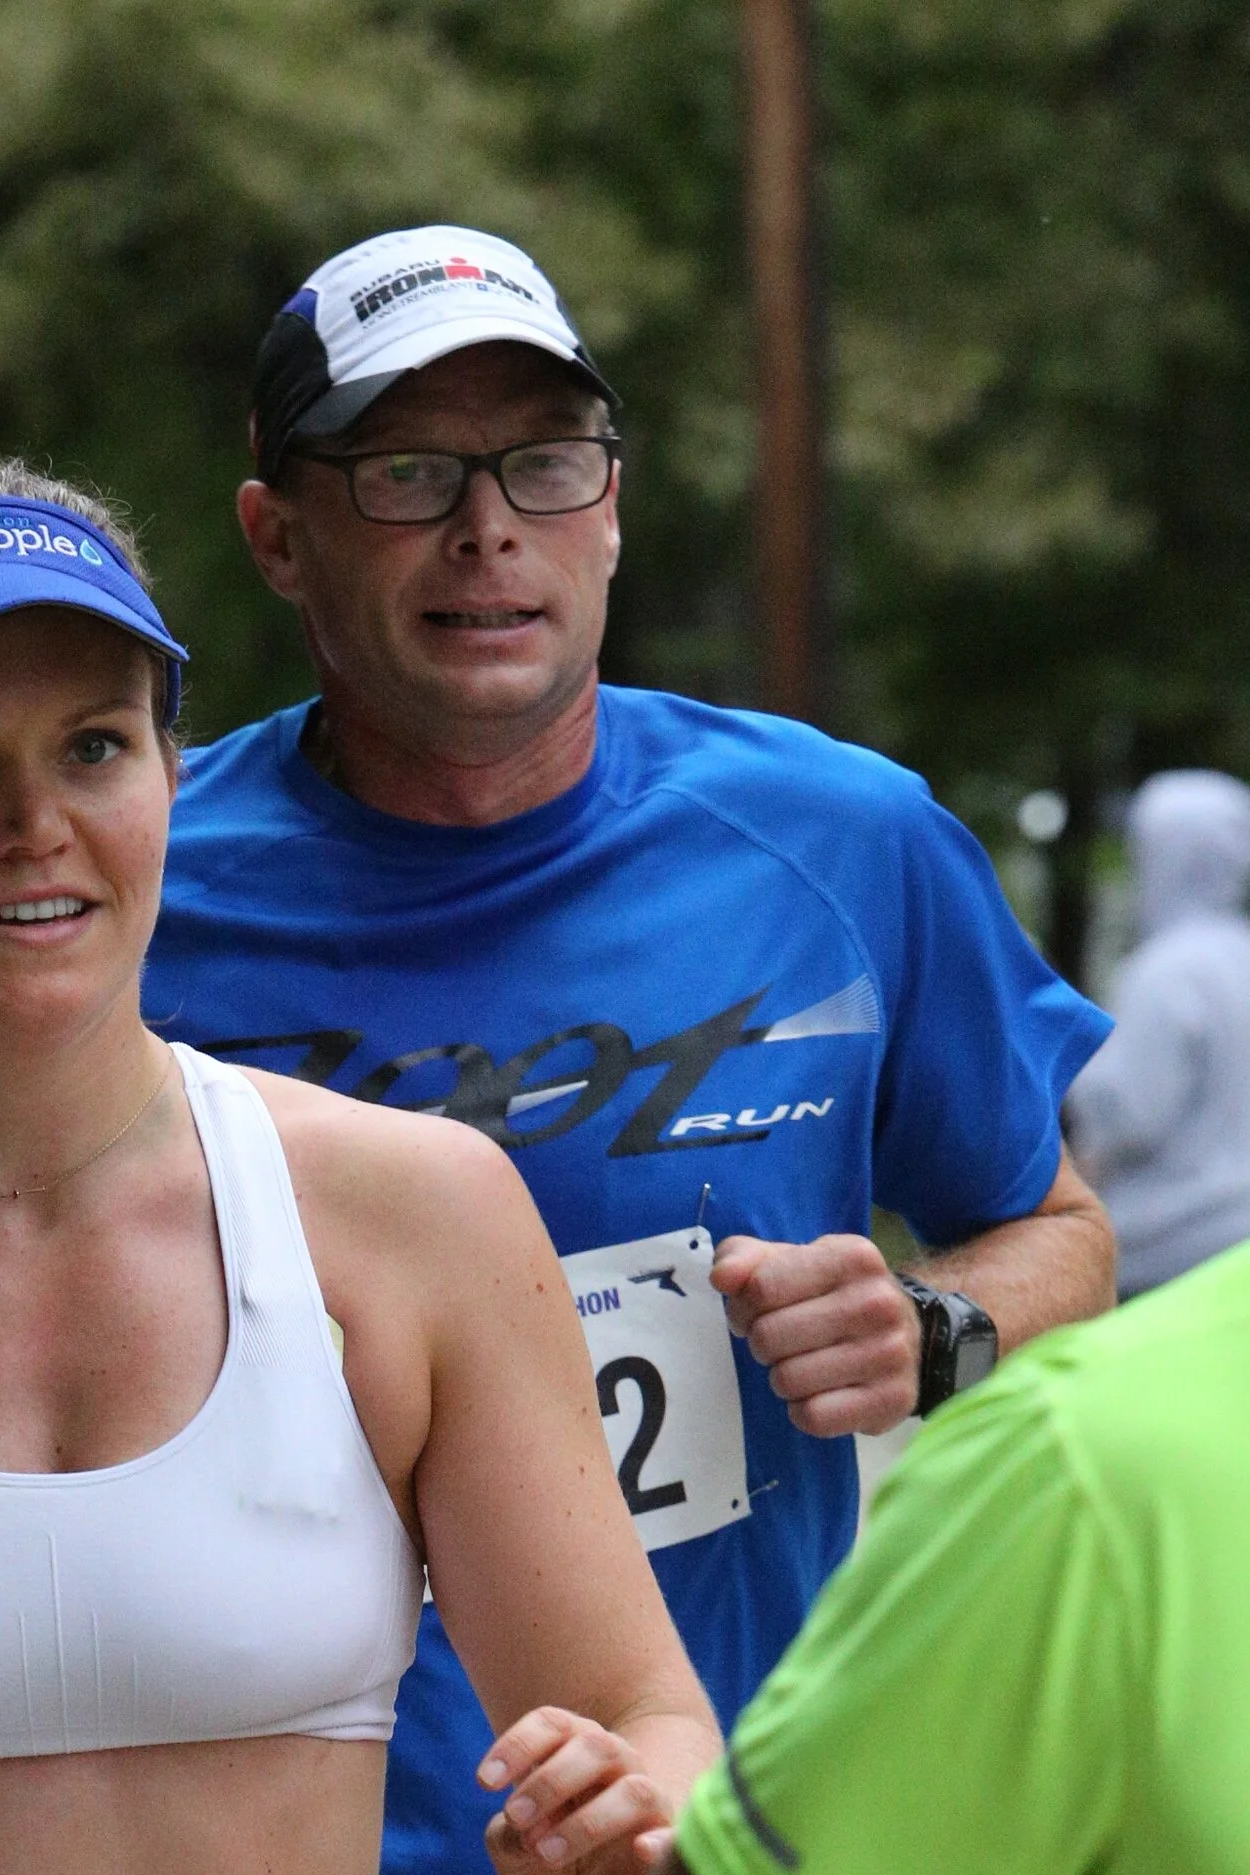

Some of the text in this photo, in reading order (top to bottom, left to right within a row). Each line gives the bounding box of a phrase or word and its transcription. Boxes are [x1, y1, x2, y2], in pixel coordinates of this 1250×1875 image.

[354, 257, 533, 322] IRONMAN
[668, 1097, 835, 1137] RUN
[595, 1355, 688, 1516] 2
